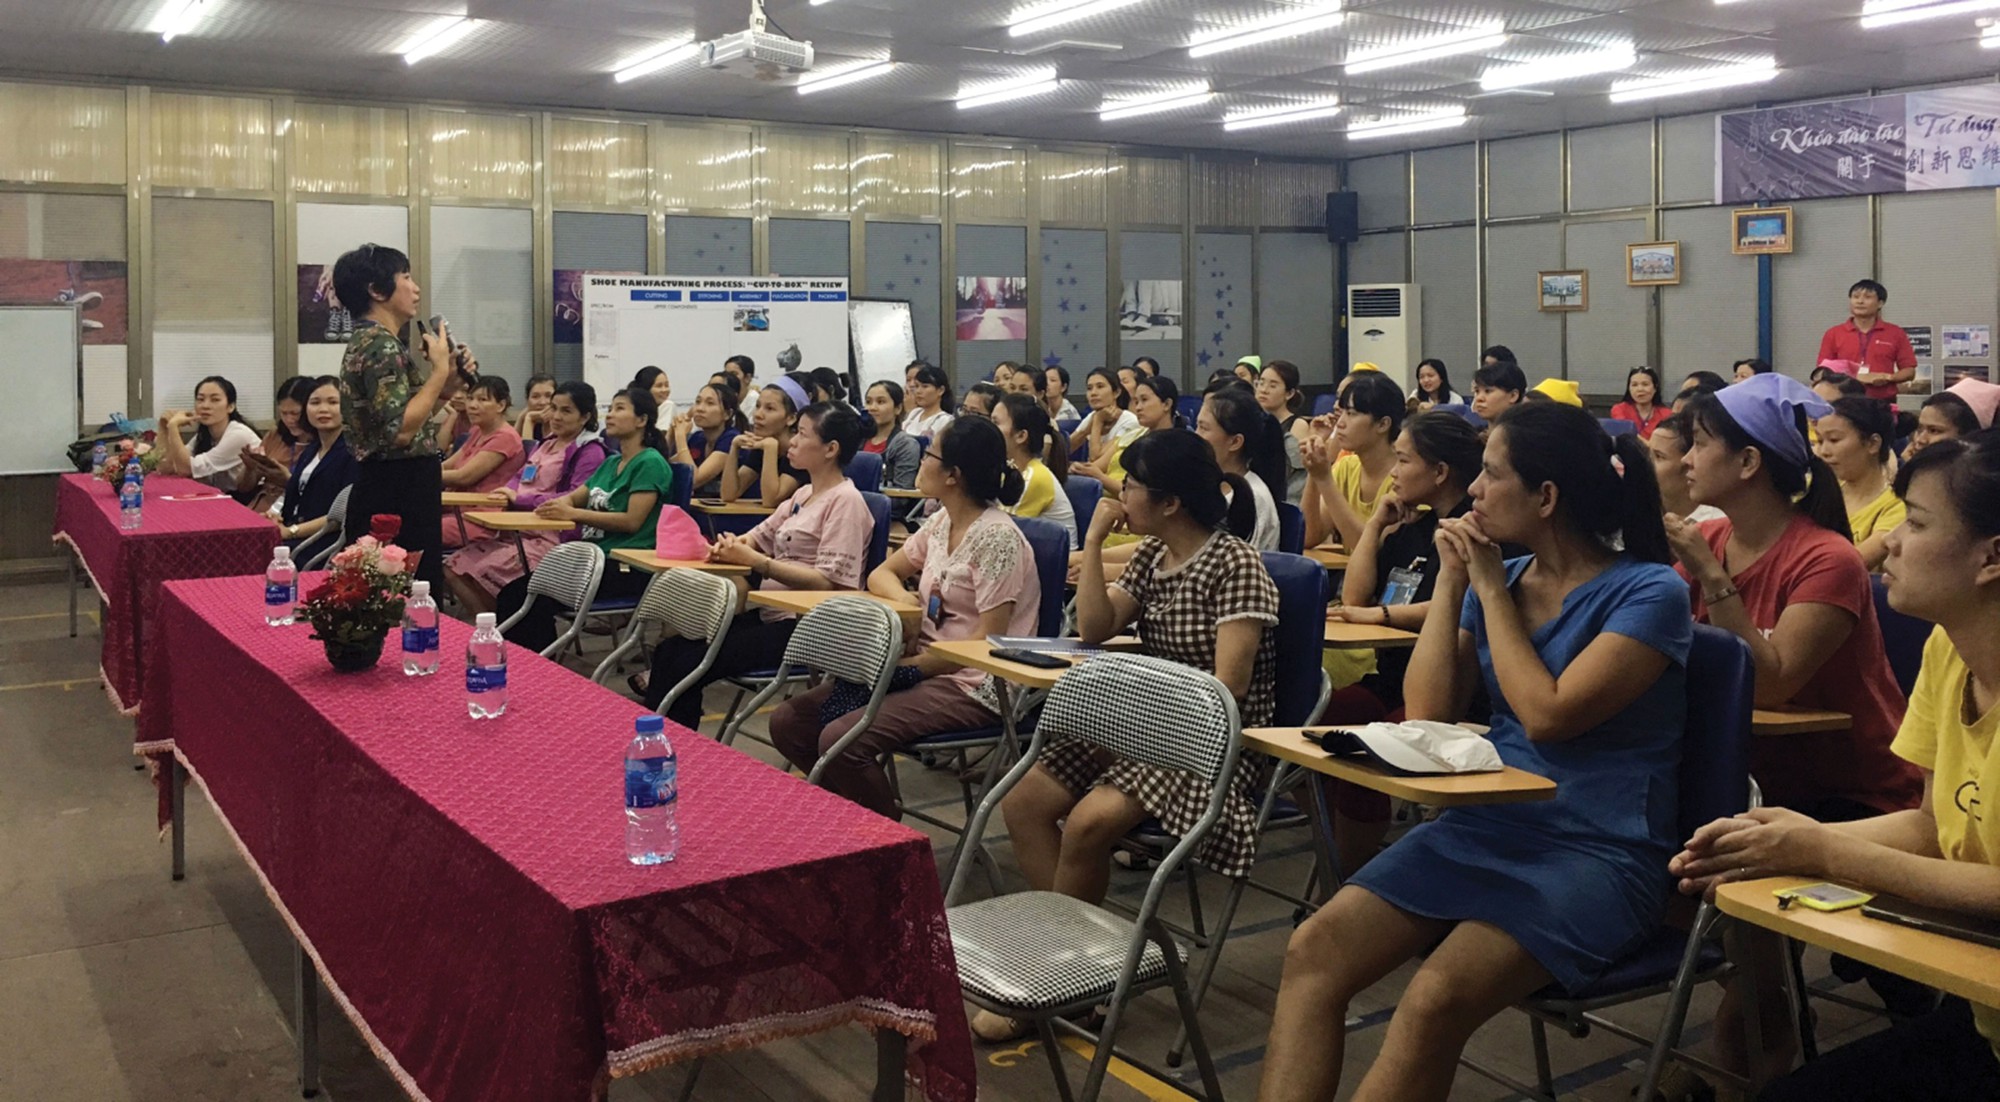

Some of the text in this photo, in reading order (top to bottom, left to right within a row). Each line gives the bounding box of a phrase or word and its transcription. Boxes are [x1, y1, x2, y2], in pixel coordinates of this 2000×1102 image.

[591, 278, 617, 286] SHOE
[620, 279, 701, 288] MANUFACTURING
[703, 280, 746, 288] PROCESS:
